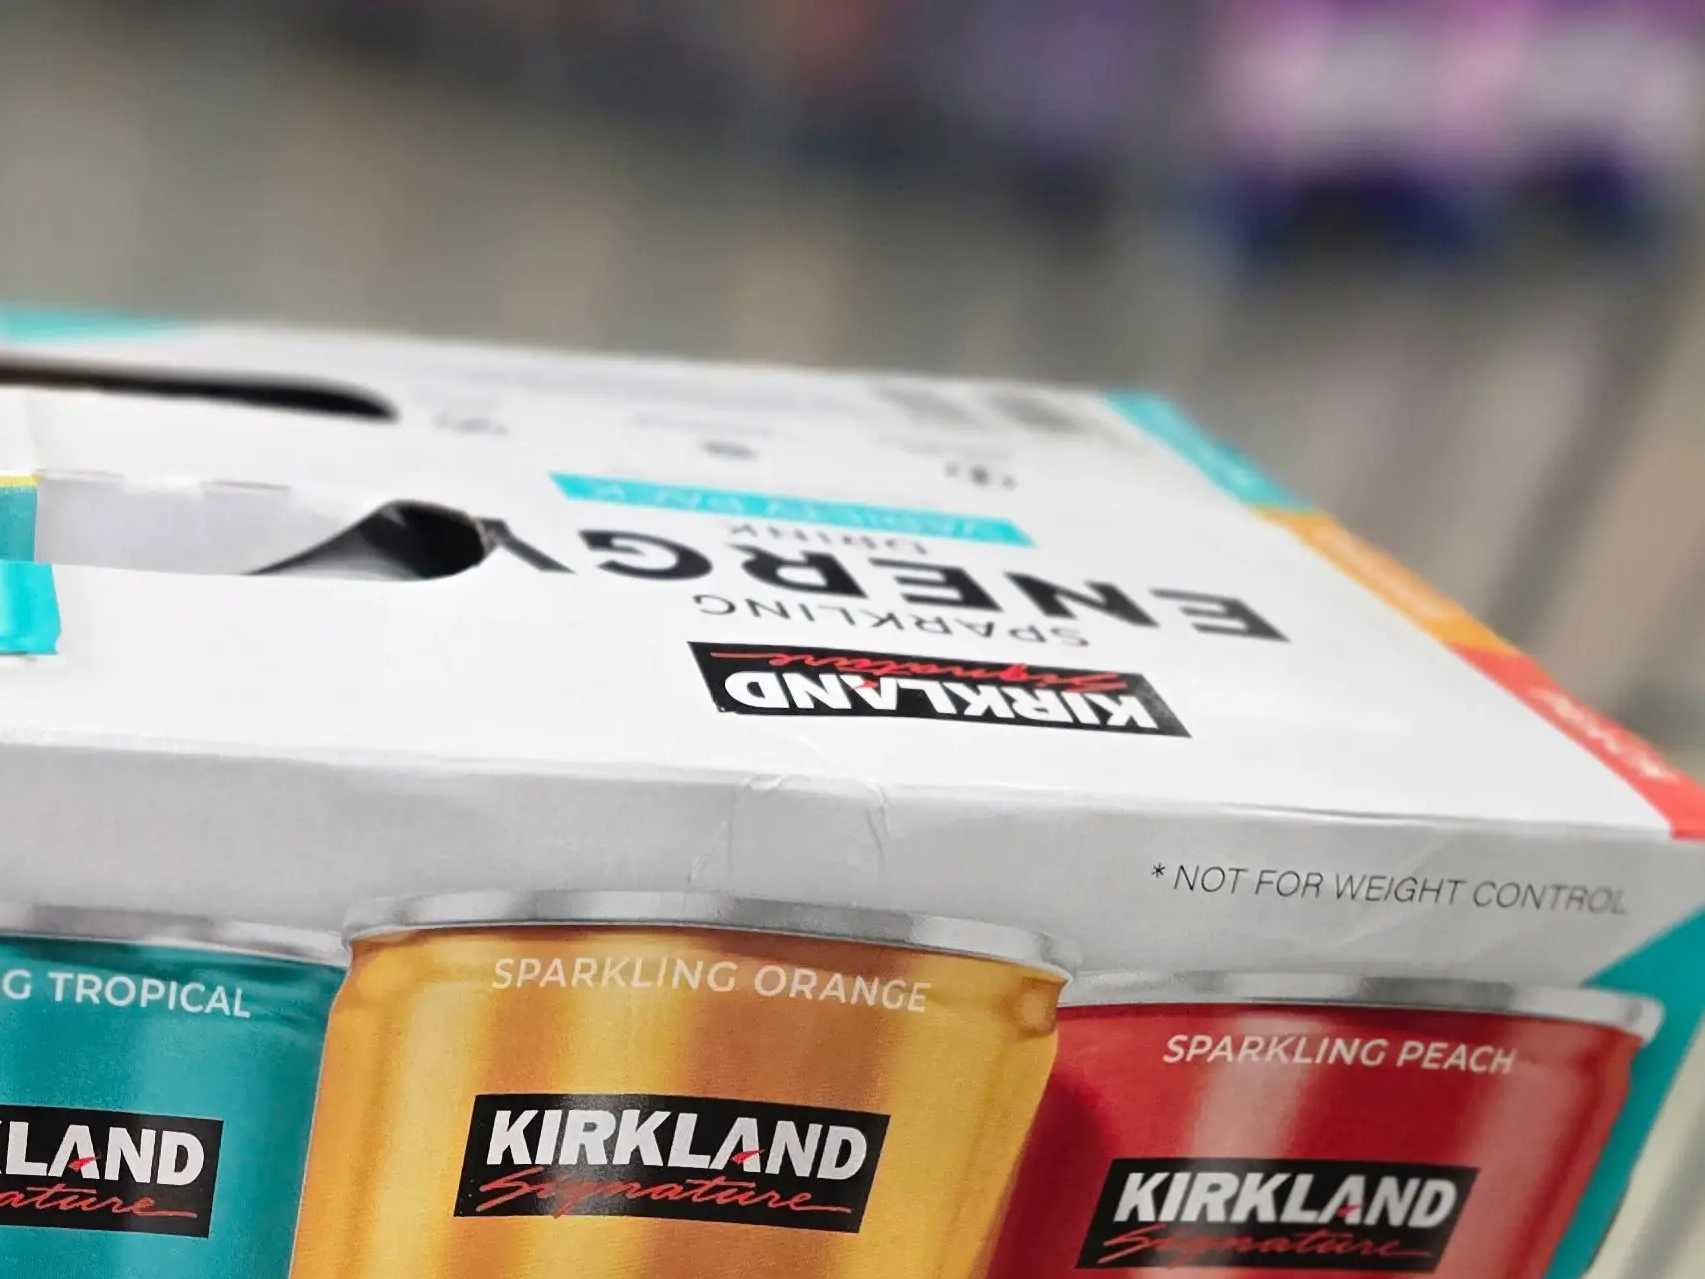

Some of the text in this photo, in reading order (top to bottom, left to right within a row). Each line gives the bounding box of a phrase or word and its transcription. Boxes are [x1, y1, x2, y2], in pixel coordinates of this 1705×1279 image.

[726, 522, 931, 555] DRINK
[481, 516, 1291, 642] ENERGY
[691, 593, 1090, 649] SPARKLING
[724, 668, 1158, 730] KIRKLAND
[1174, 866, 1629, 917] NOT FOR WEIGHT CONTROL
[48, 971, 251, 1019] TROPICAL
[492, 959, 931, 1013] SPARKLING ORANGE
[1163, 1034, 1518, 1075] SPARKLING PEACH
[487, 1108, 868, 1181] KIRKLAND
[475, 1165, 853, 1219] Signature
[1113, 1170, 1458, 1230] KIRKLAND
[1097, 1223, 1433, 1271] Signature
